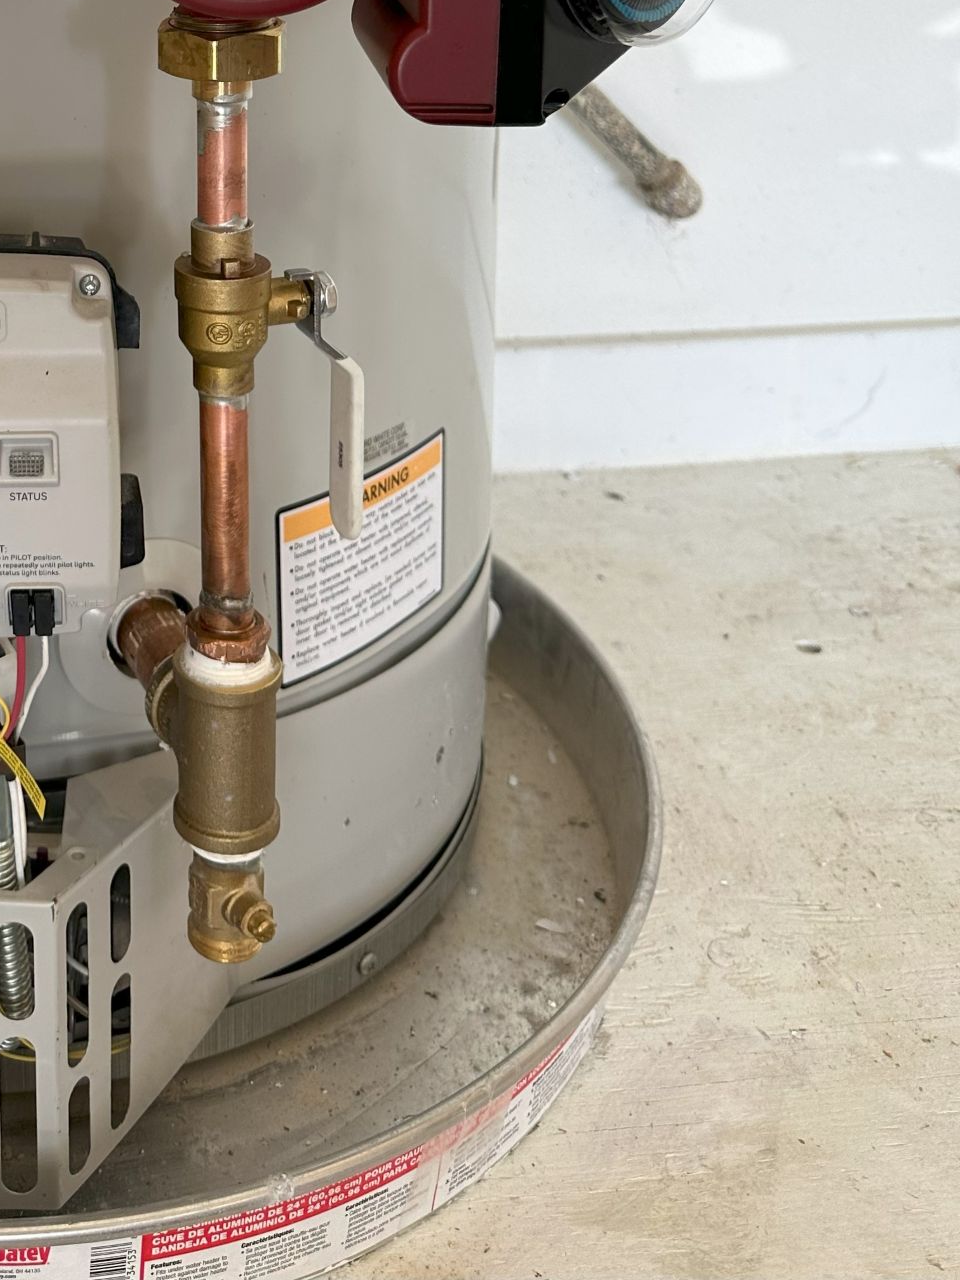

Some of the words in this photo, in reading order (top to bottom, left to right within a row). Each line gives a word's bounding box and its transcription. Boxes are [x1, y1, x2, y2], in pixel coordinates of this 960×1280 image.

[9, 492, 48, 502] STATUS
[362, 466, 409, 503] ARNING
[152, 1235, 183, 1246] CUVE
[188, 1228, 205, 1238] DE
[207, 1213, 265, 1233] ALUMINIO
[268, 1208, 283, 1218] DE
[286, 1200, 306, 1212] 24"
[308, 1188, 342, 1204] (60,96
[344, 1175, 362, 1191] cm)
[365, 1164, 393, 1180] POUR
